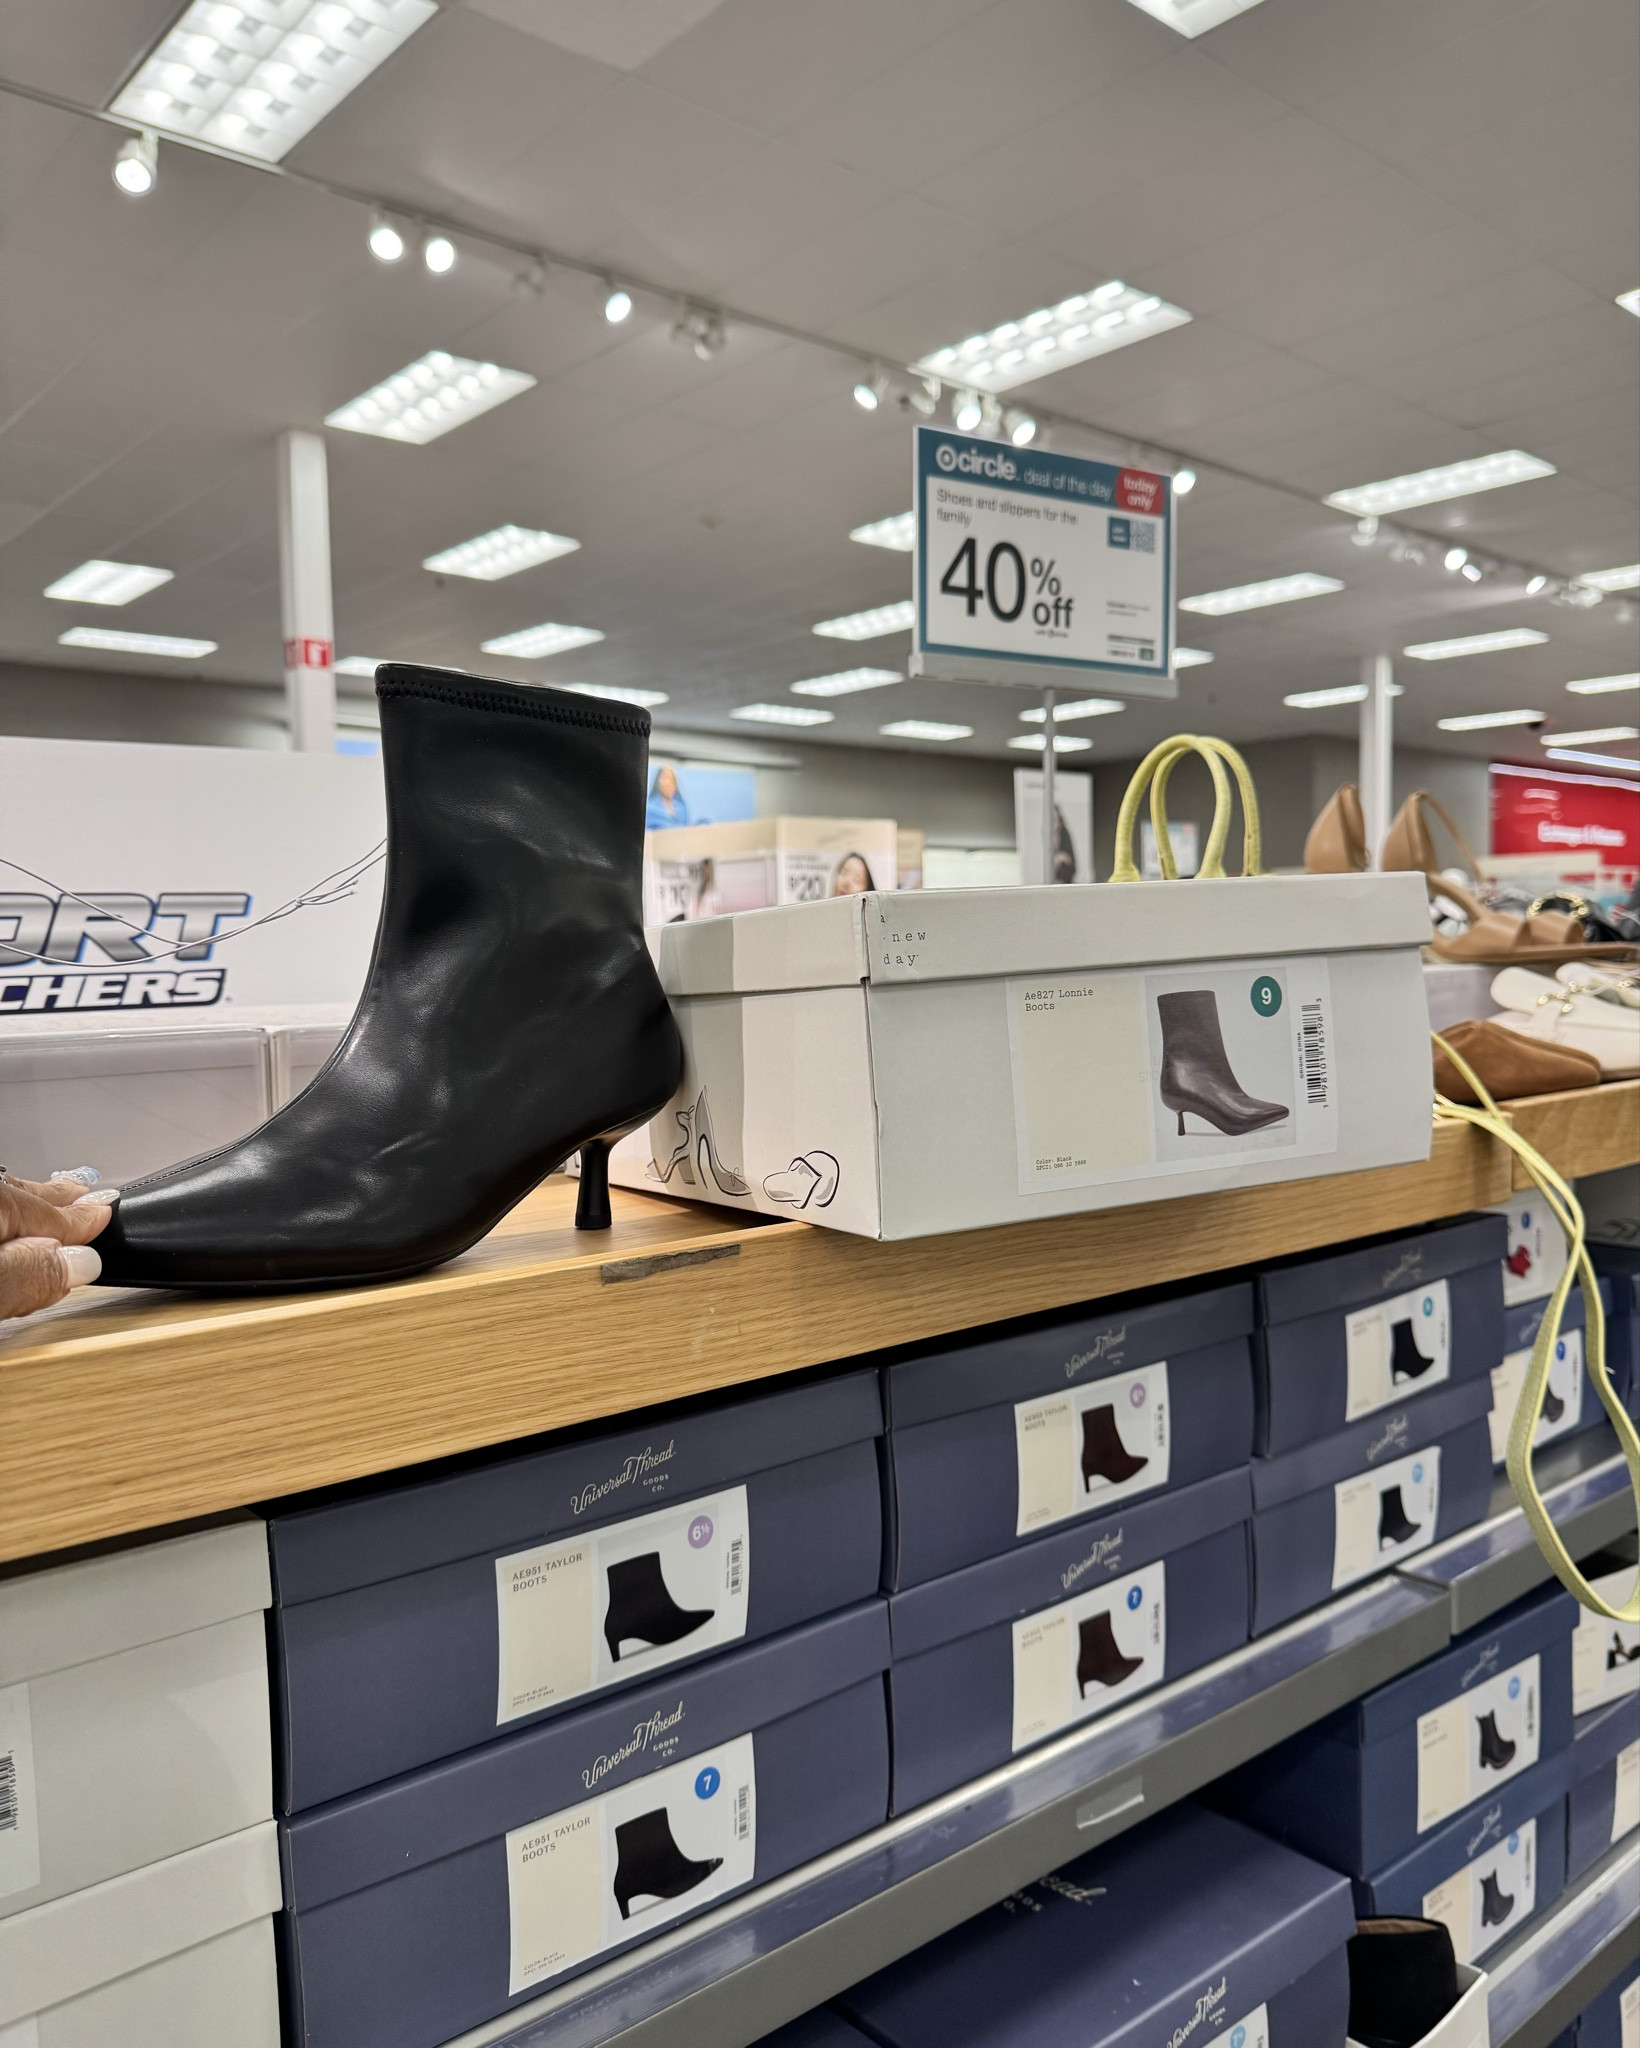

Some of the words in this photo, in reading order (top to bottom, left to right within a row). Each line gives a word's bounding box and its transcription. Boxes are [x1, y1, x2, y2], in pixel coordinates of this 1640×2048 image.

[1024, 468, 1050, 487] deal
[1089, 481, 1113, 501] day
[1124, 475, 1157, 496] today
[937, 488, 972, 505] Shoes
[976, 495, 996, 511] and
[998, 498, 1041, 519] slippers
[1043, 505, 1059, 522] for
[1061, 510, 1078, 526] the
[1127, 493, 1154, 511] only
[937, 508, 972, 528] family
[1032, 597, 1073, 629] off
[880, 914, 886, 924] a
[891, 931, 926, 943] new
[883, 953, 916, 967] day
[1024, 990, 1054, 1001] Ae827
[1059, 987, 1094, 998] Lonnie
[1260, 988, 1273, 1005] 9
[1025, 1003, 1055, 1012] Boots
[570, 1461, 633, 1515] Universal
[623, 1439, 674, 1485] Thread
[643, 1473, 669, 1486] GOODS
[512, 1565, 541, 1581] AE951
[545, 1553, 582, 1571] TAYLOR
[513, 1575, 547, 1592] BOOTS
[581, 1728, 643, 1789] Universal
[633, 1700, 683, 1752] Thread
[653, 1736, 679, 1751] GOODS
[703, 1774, 712, 1791] 7
[521, 1833, 550, 1852] AE951
[554, 1816, 591, 1838] TAYLOR
[522, 1842, 556, 1863] BOOTS
